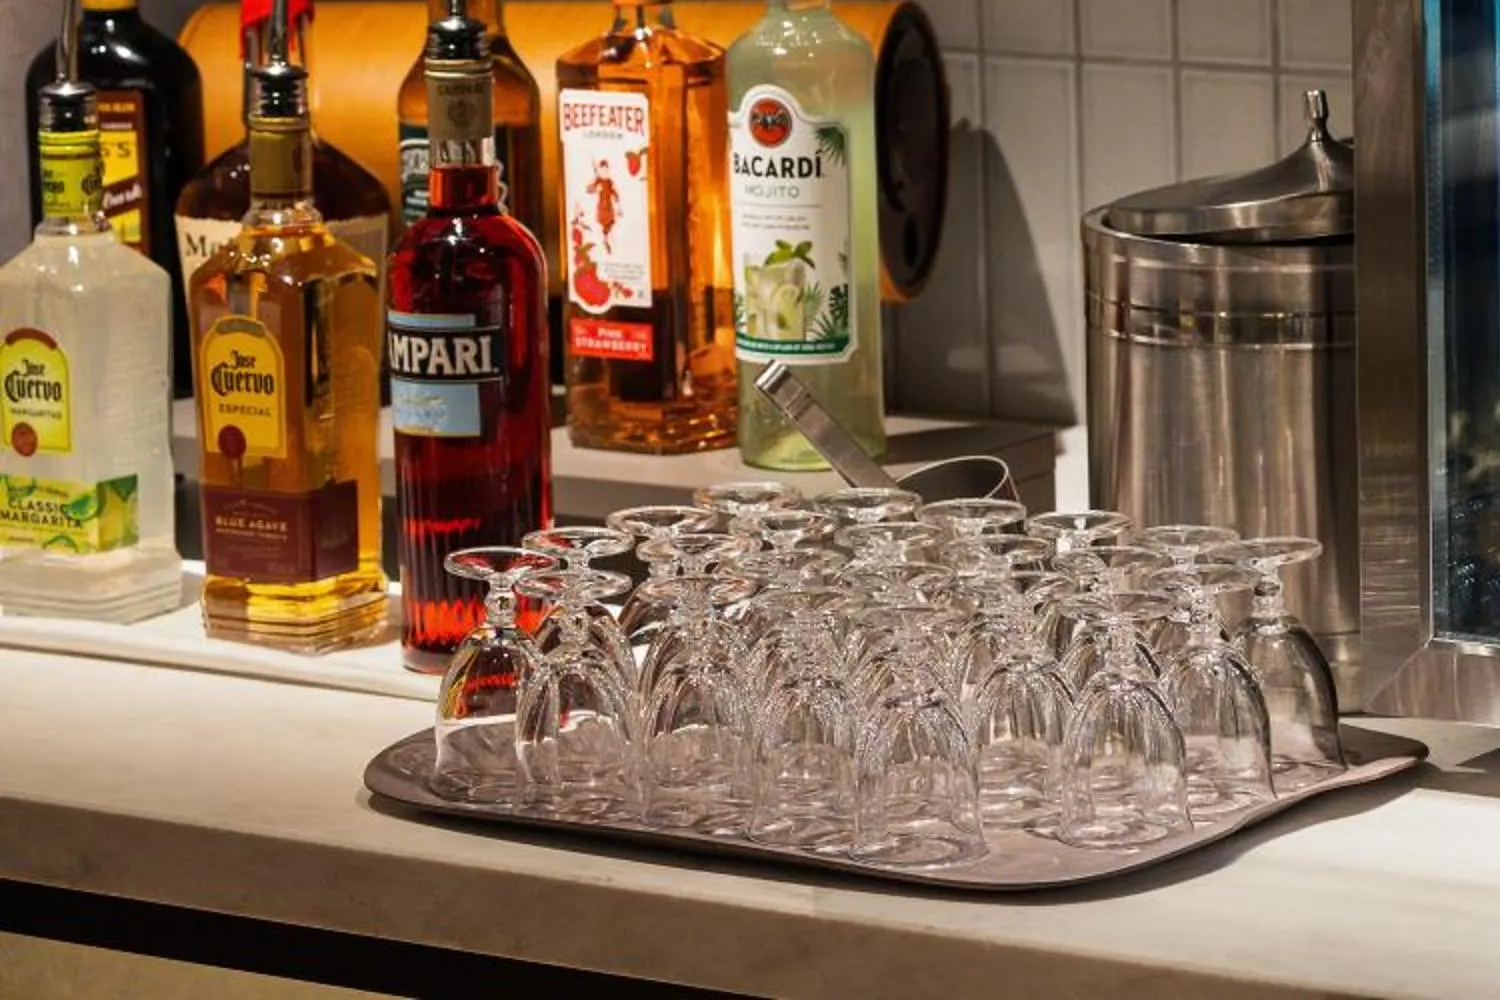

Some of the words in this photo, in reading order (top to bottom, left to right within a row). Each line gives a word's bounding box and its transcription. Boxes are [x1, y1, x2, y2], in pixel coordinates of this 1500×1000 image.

[563, 103, 645, 135] BEEFEATER
[733, 149, 823, 178] BACARDÍ
[744, 184, 800, 198] MOJITO
[575, 337, 648, 352] STRAWBERRY
[230, 349, 257, 368] Jose
[4, 370, 62, 403] Cuervo
[210, 363, 276, 397] Cuervo
[218, 403, 272, 417] ESPECIAL
[0, 510, 83, 529] MARGARITA
[249, 520, 288, 532] AGAVE
